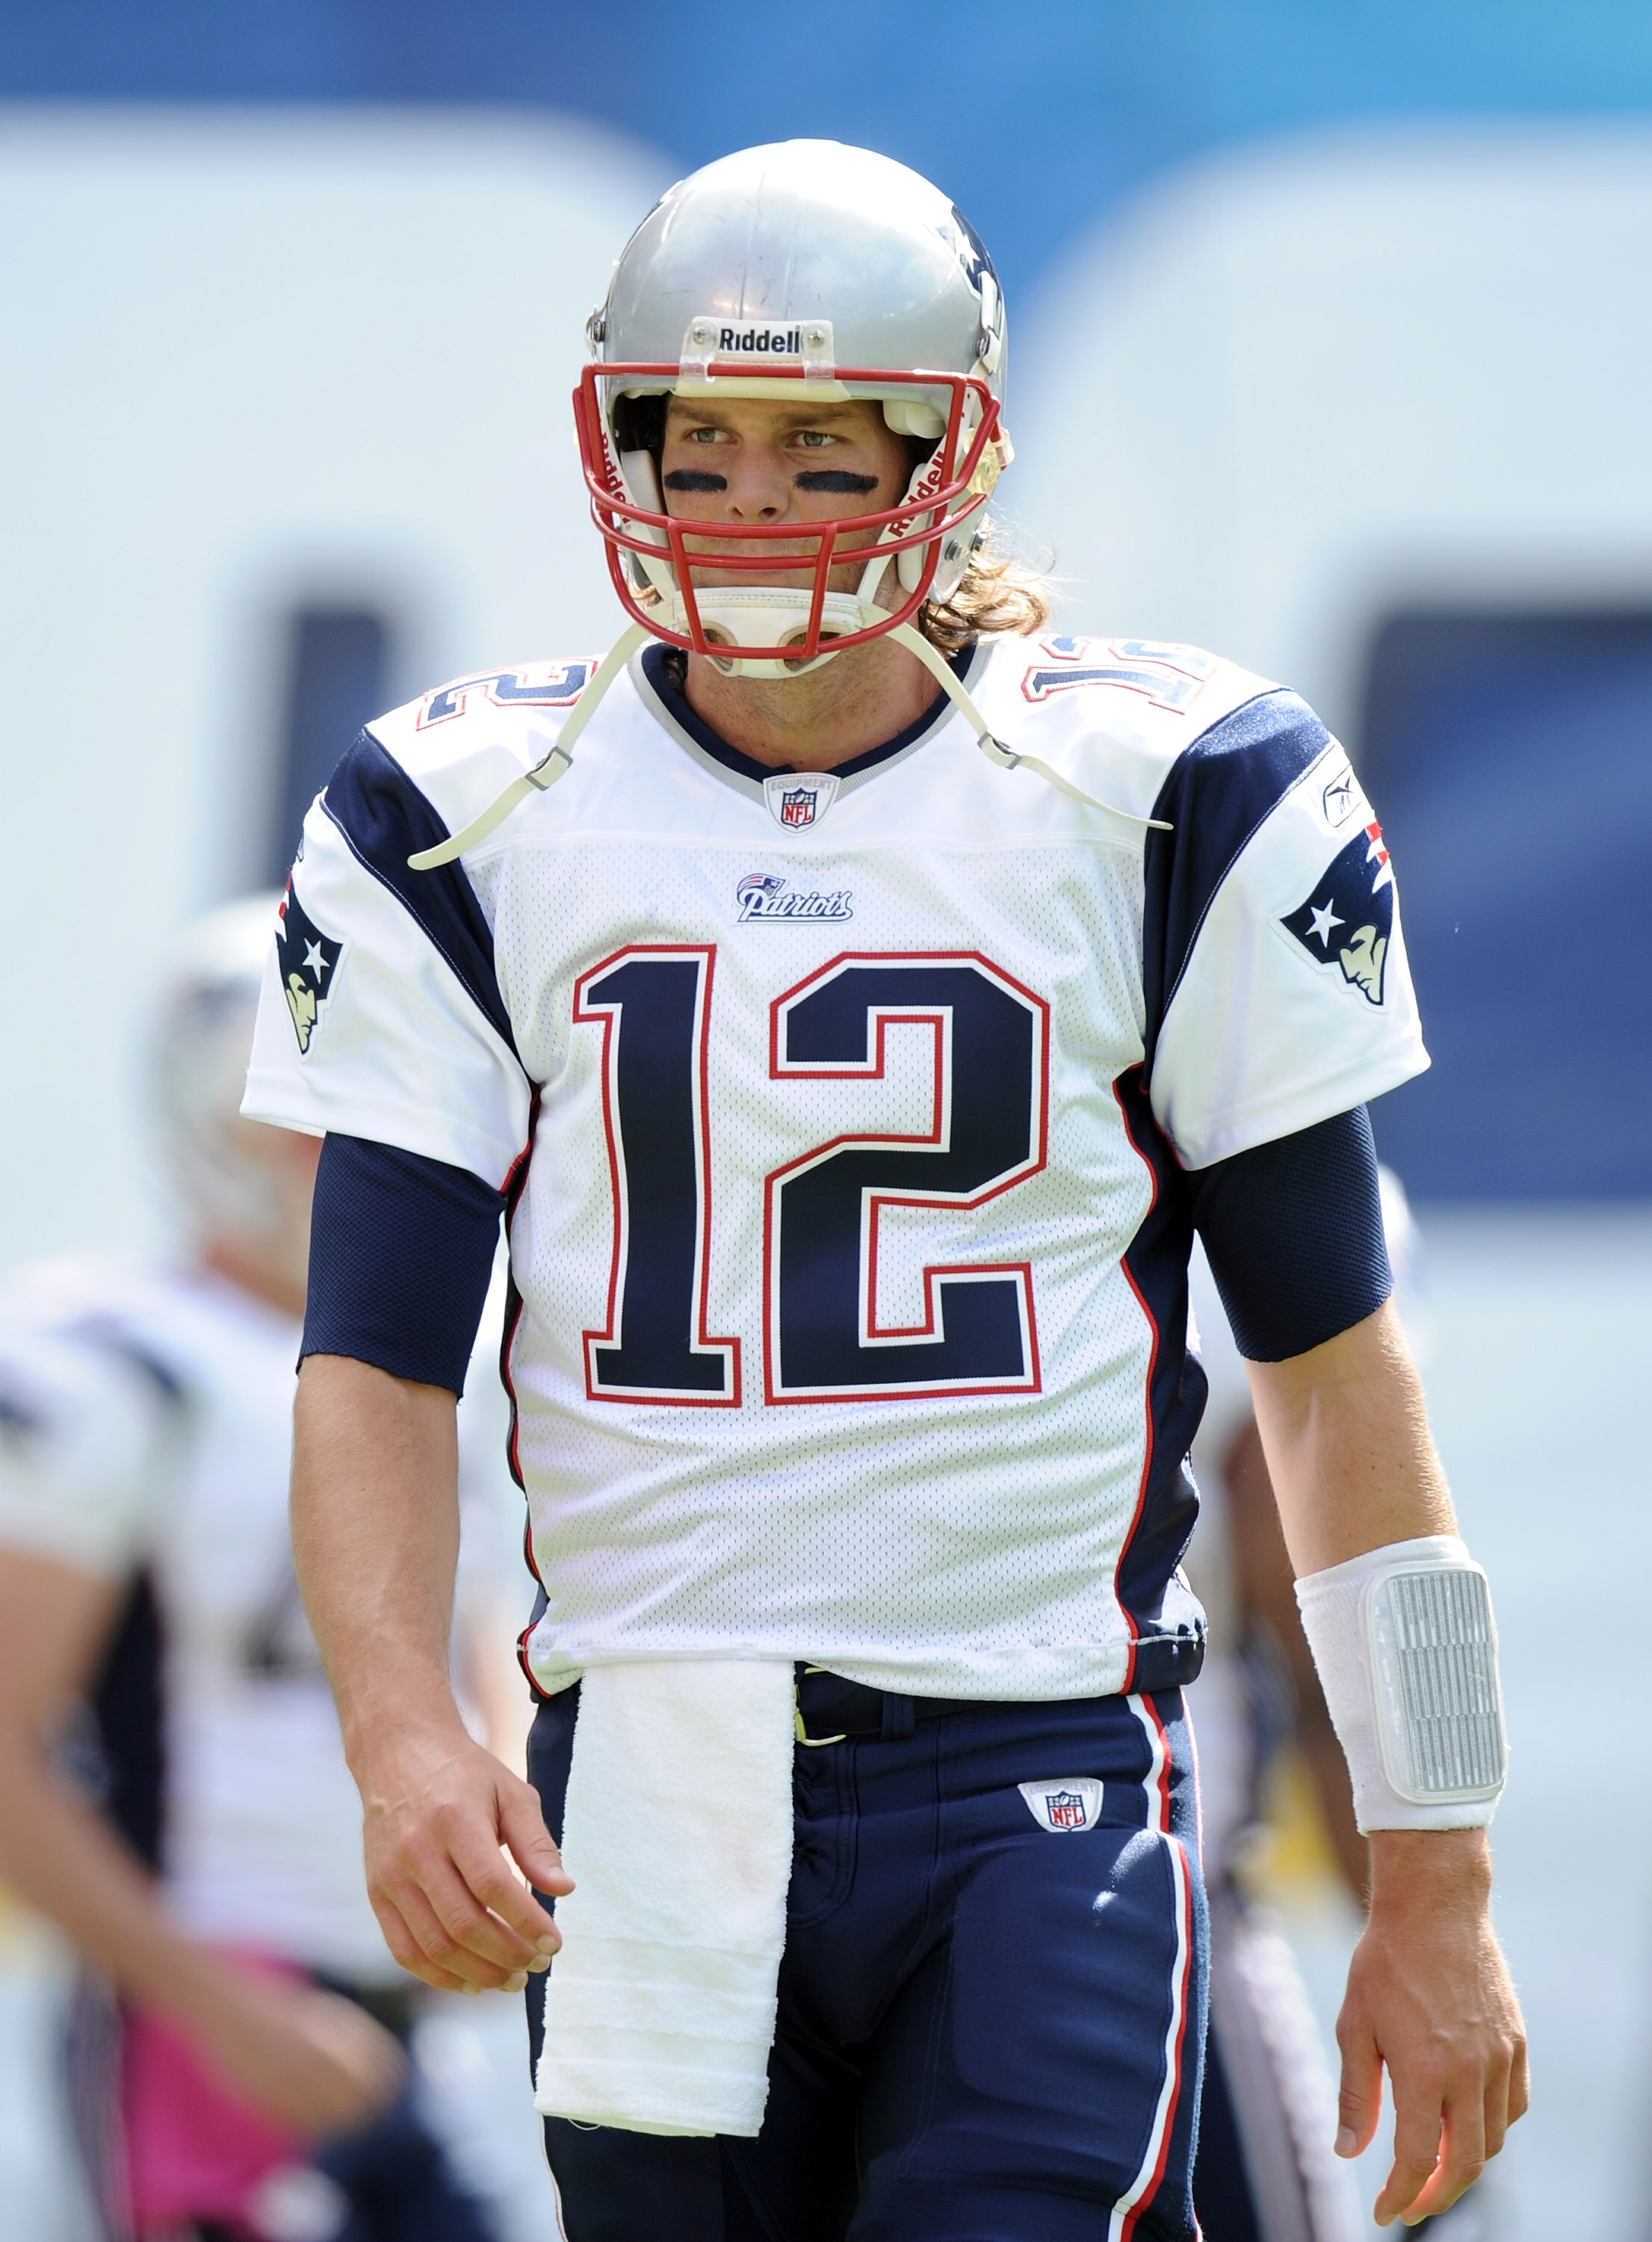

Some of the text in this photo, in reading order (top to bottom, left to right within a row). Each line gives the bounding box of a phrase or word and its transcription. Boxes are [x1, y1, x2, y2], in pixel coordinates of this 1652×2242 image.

[719, 327, 801, 354] Riddell
[888, 451, 945, 538] Rdel
[784, 804, 813, 824] NFL
[737, 889, 854, 923] Patriots
[572, 943, 1051, 1409] 12
[1051, 1806, 1083, 1826] NFL
